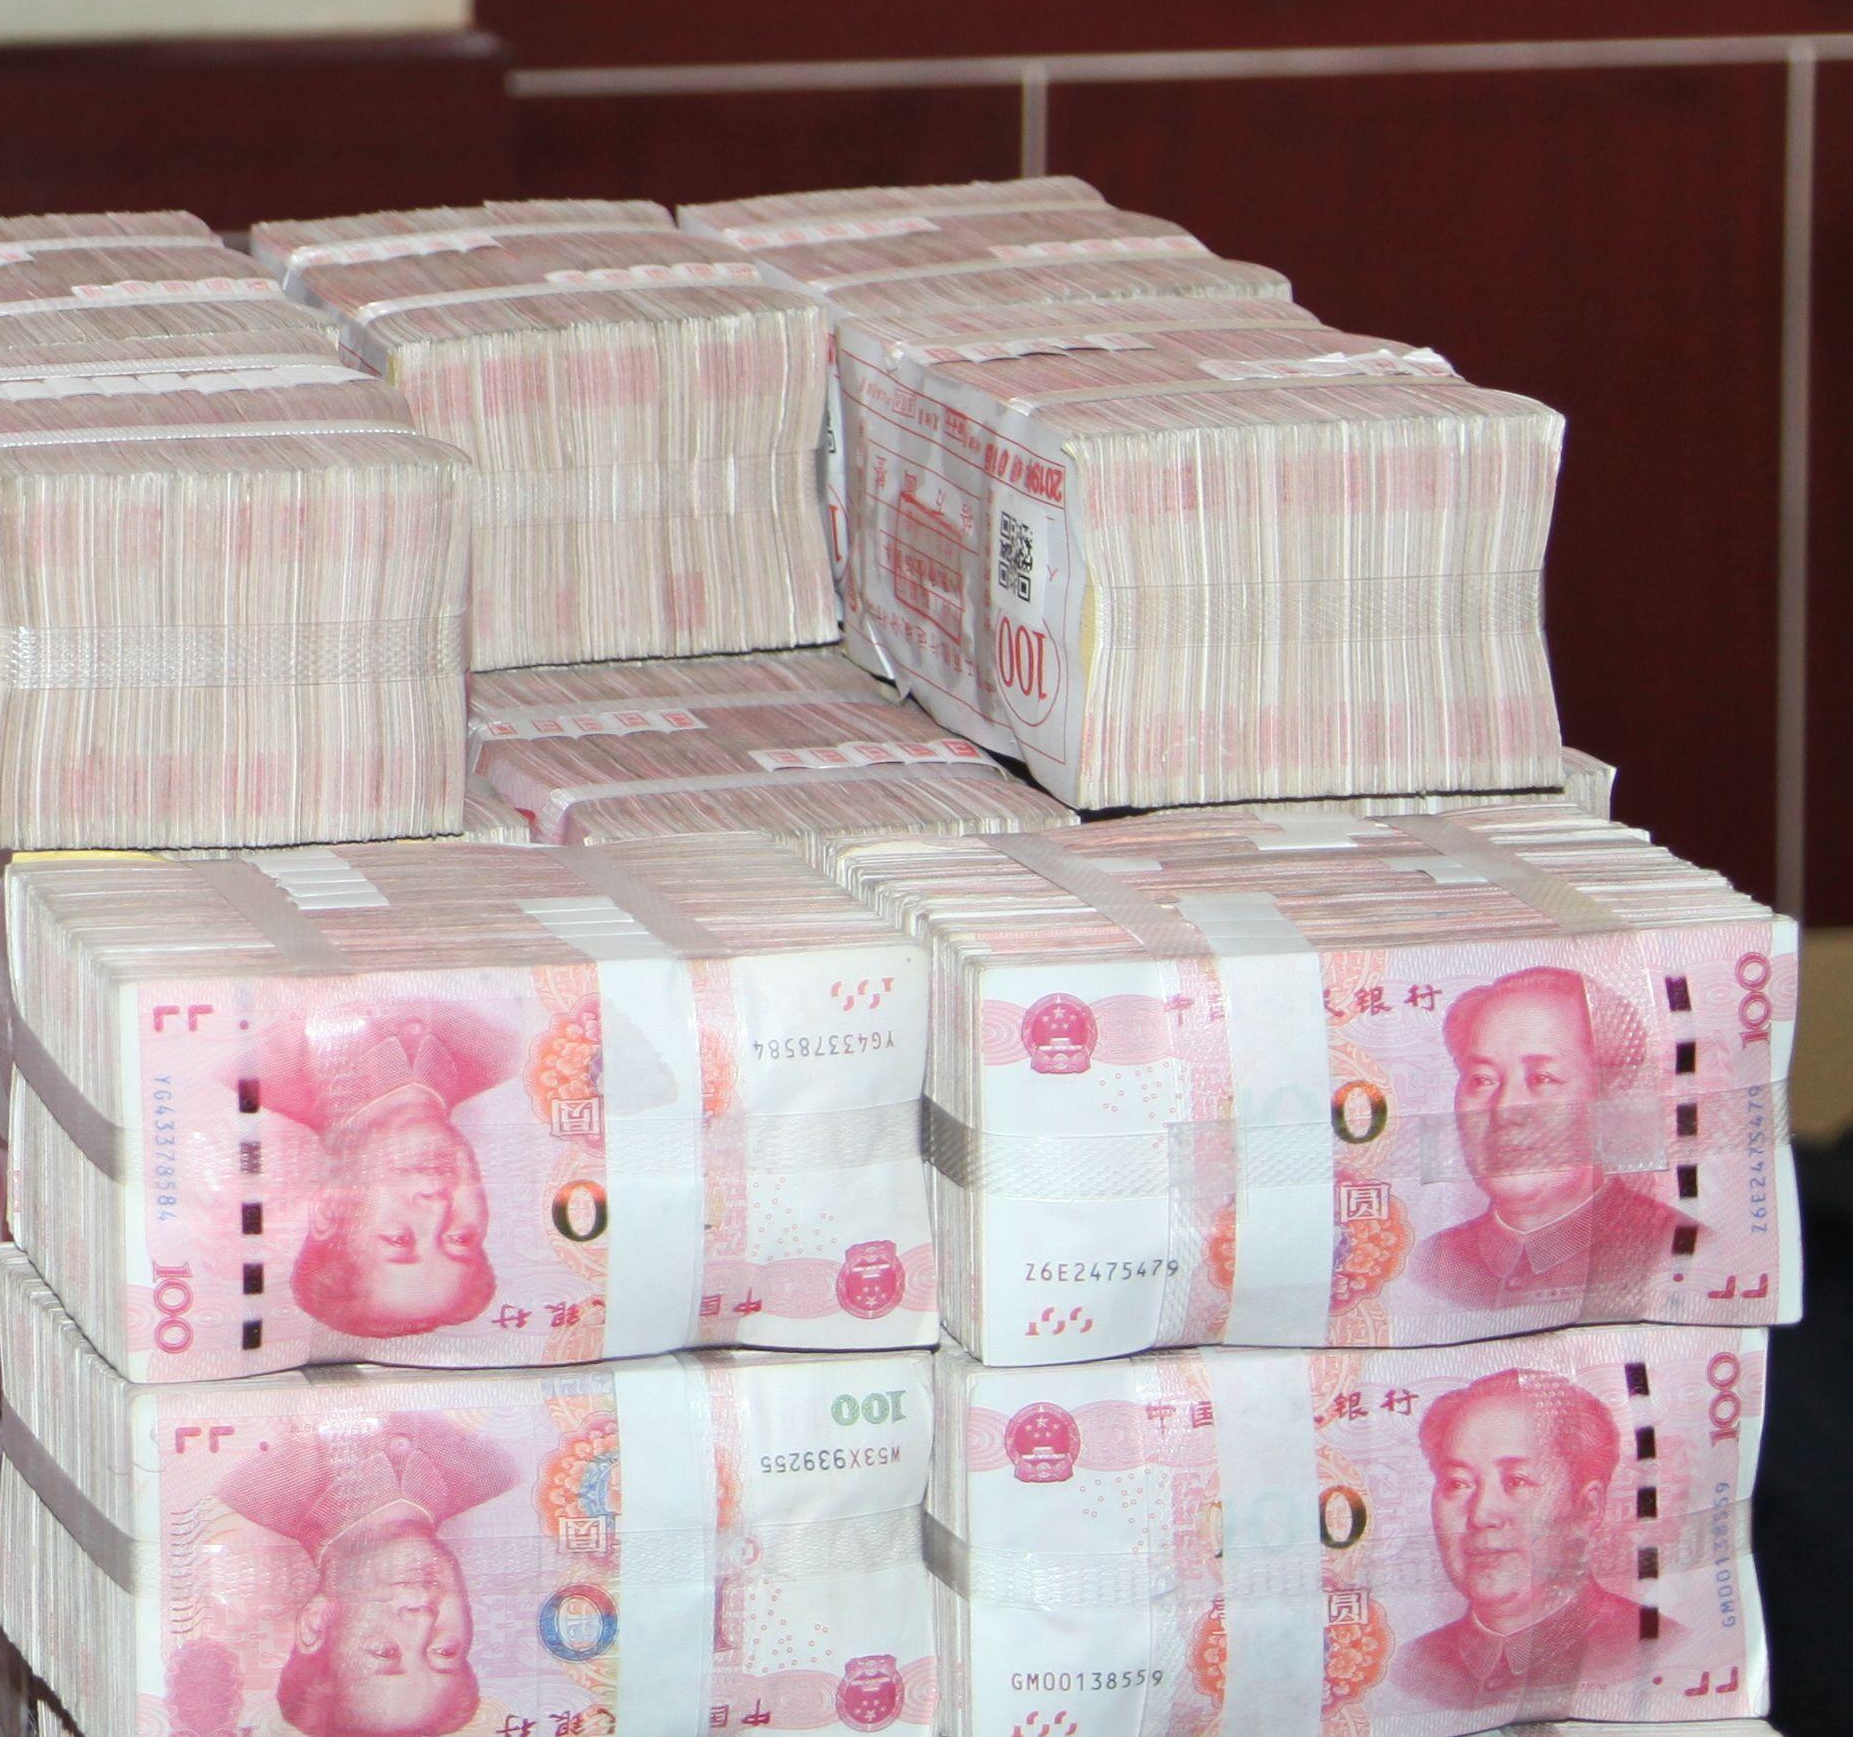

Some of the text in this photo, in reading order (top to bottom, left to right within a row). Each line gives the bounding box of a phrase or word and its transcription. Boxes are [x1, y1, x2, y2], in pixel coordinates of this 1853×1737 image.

[997, 615, 1048, 701] 100
[1735, 951, 1773, 1049] 100
[753, 1031, 894, 1060] YG43378584
[153, 1075, 178, 1222] YG43378584
[1746, 1085, 1770, 1235] Z6E2475479
[152, 1260, 194, 1355] 100
[1024, 1260, 1180, 1283] Z6E2475479
[829, 1389, 907, 1427] 100
[1706, 1351, 1742, 1447] 100
[759, 1445, 902, 1475] W53X939255
[1714, 1481, 1737, 1629] GM00138559
[1010, 1669, 1164, 1692] GM00138559
